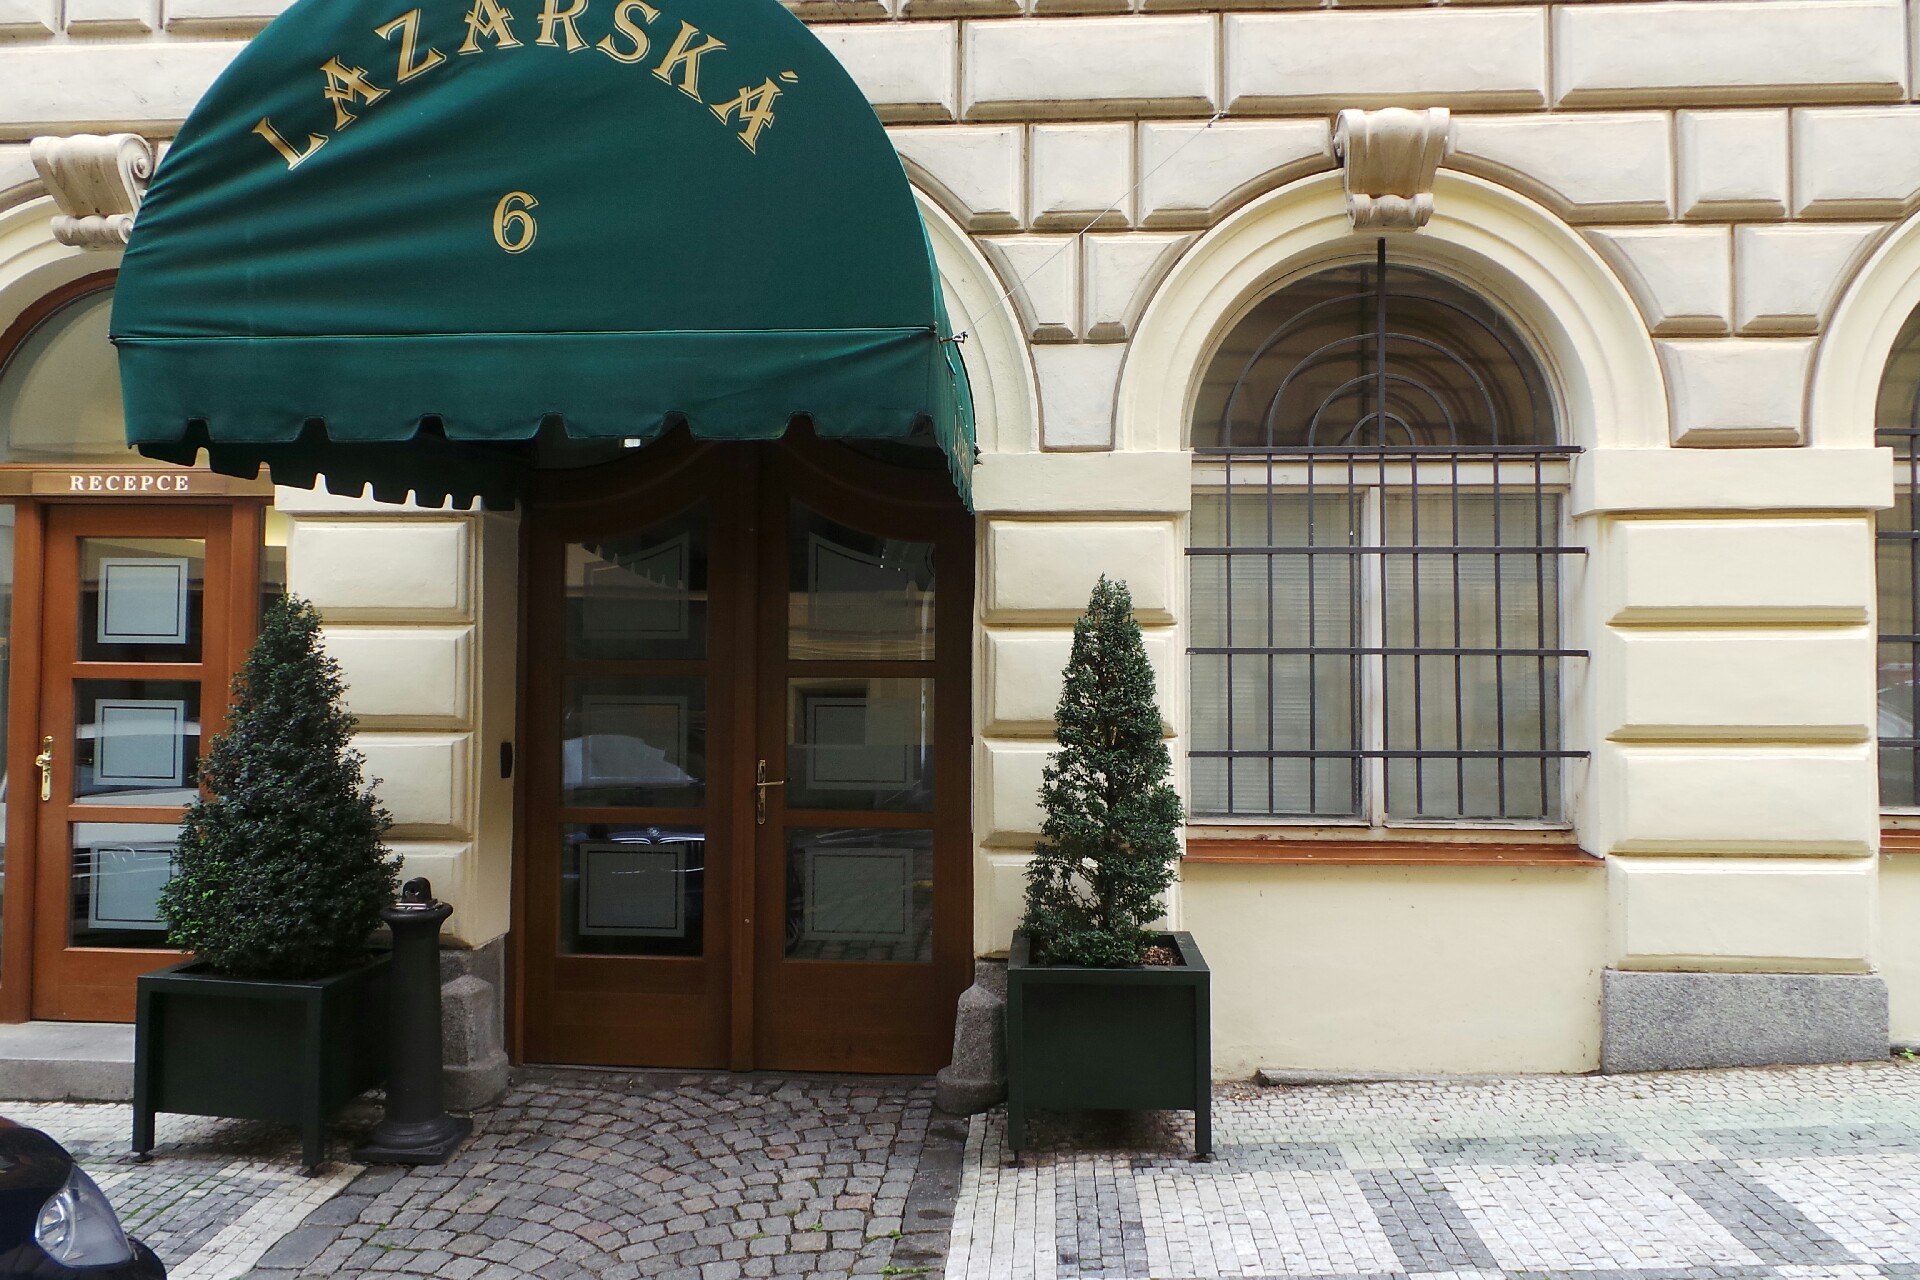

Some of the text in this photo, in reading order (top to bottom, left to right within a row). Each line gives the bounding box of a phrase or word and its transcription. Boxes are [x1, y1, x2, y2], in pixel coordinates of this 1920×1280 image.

[251, 0, 799, 171] LAZARSKÁ
[492, 190, 539, 254] 6
[69, 475, 190, 491] RECEPCE
